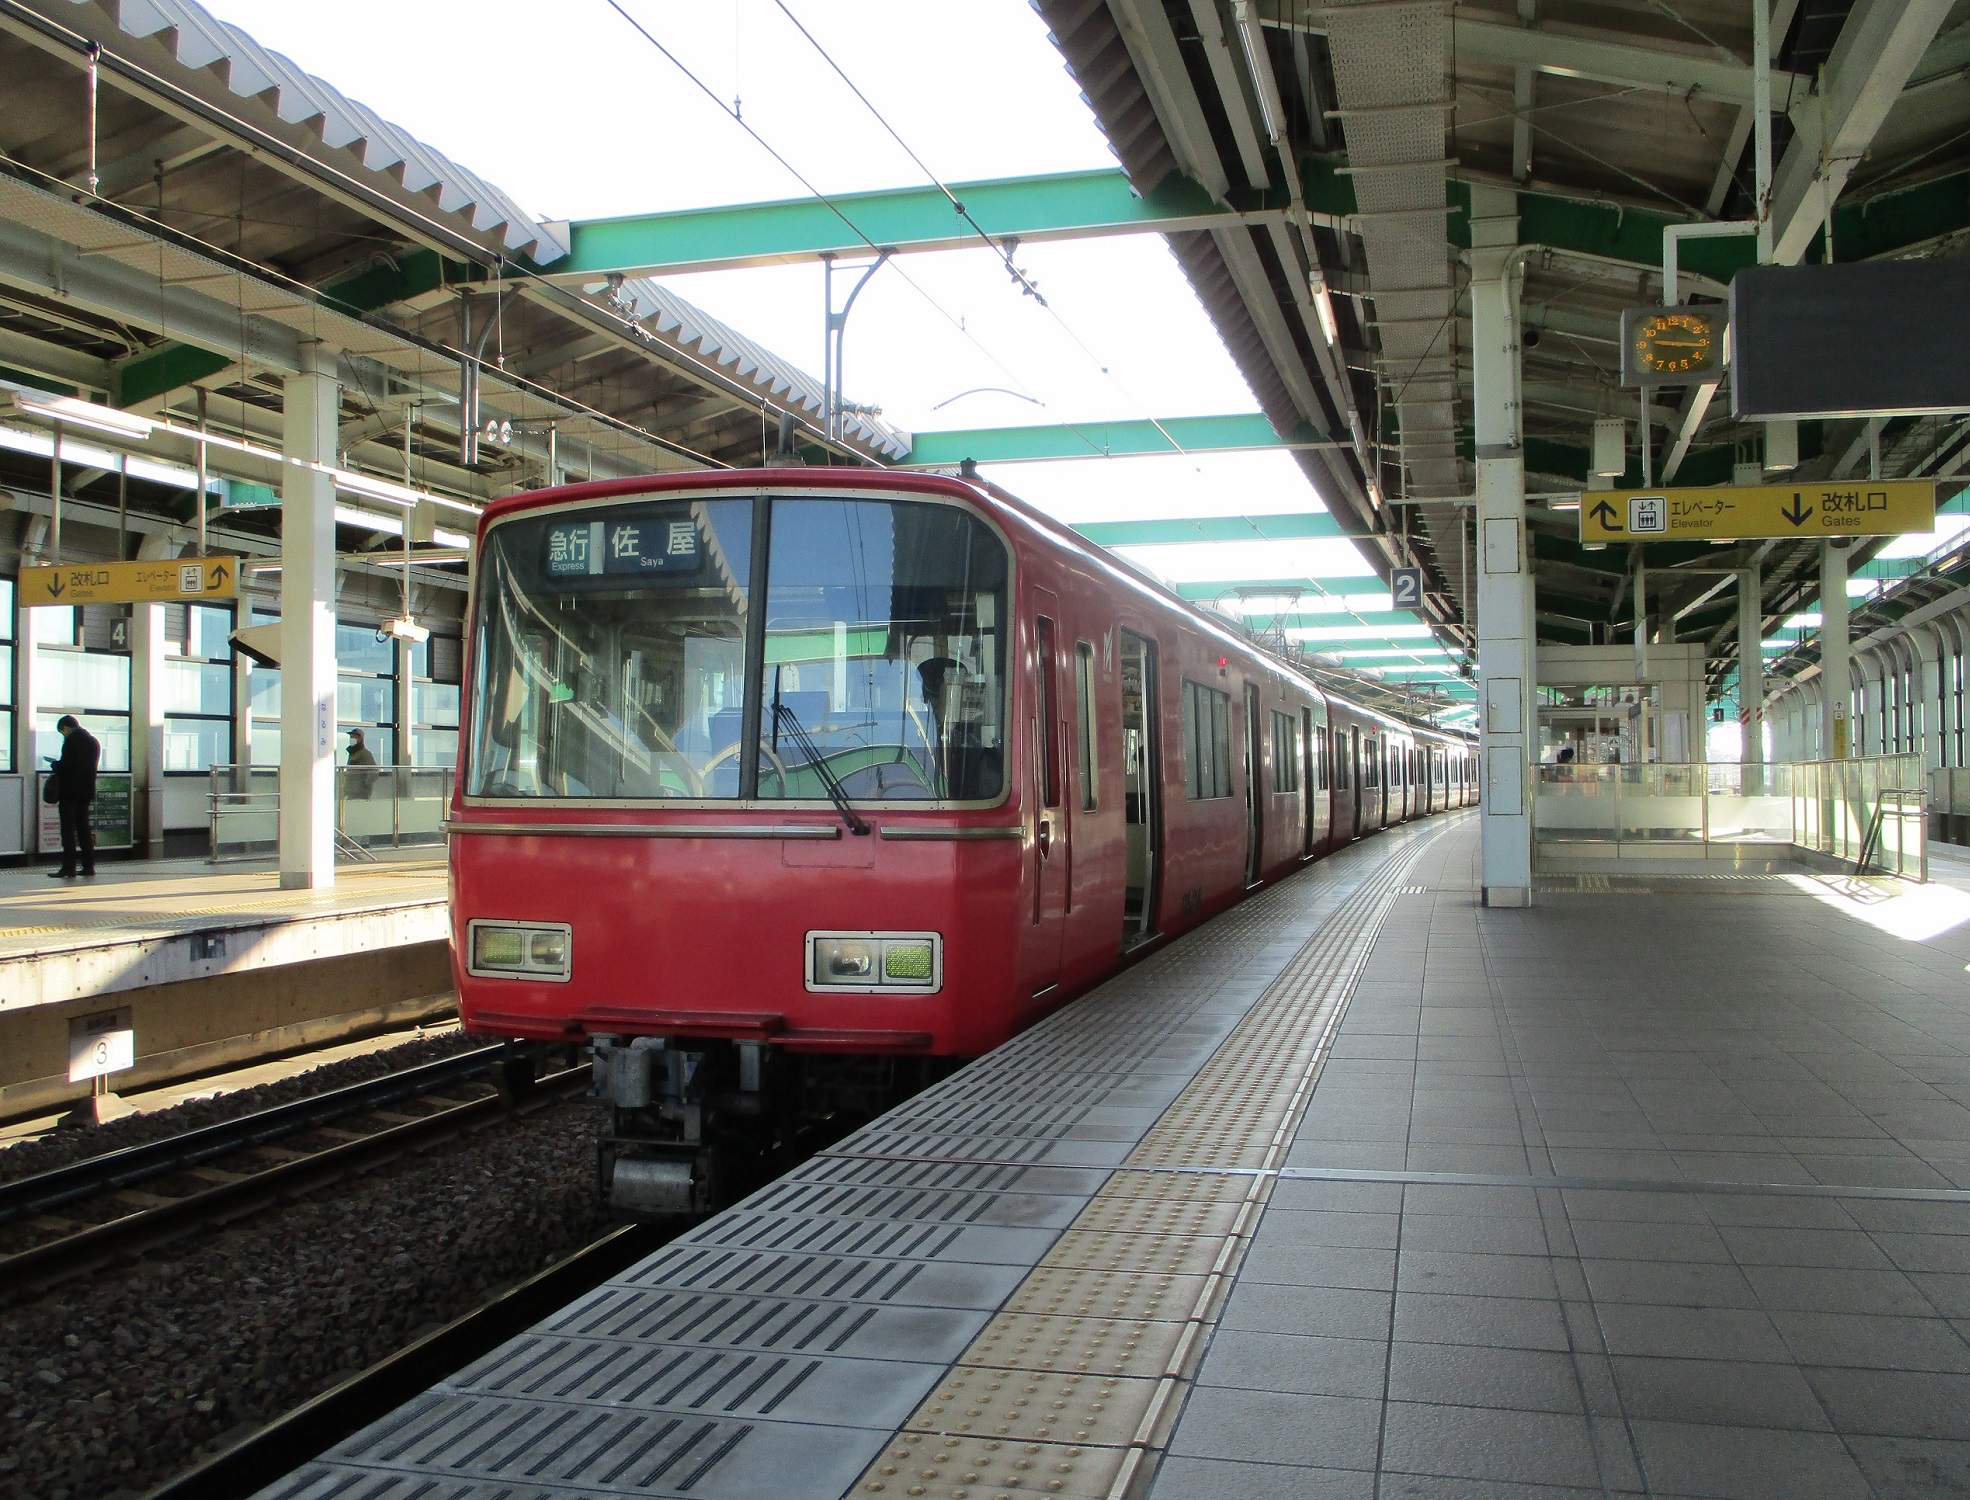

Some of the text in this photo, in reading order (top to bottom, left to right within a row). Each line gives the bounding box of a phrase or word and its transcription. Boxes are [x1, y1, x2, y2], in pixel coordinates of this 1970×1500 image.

[1667, 318, 1678, 326] 12
[1682, 320, 1688, 328] 1
[1645, 329, 1656, 337] 10
[1692, 352, 1700, 360] 4
[1680, 360, 1688, 368] 5
[1821, 492, 1887, 512] 改札口
[1671, 500, 1736, 517] エレベーター
[1671, 518, 1714, 529] Elevator
[1822, 515, 1861, 527] Gates
[549, 529, 589, 561] 急行
[611, 521, 696, 559] 佐屋
[552, 562, 585, 572] Express
[640, 557, 664, 567] Saya
[70, 571, 110, 587] 改札口
[136, 570, 177, 583] エレベーター
[150, 584, 176, 592] Elevator
[1396, 575, 1416, 602] 2
[70, 590, 94, 598] Gates
[112, 622, 126, 645] 4
[96, 1041, 108, 1065] 3
